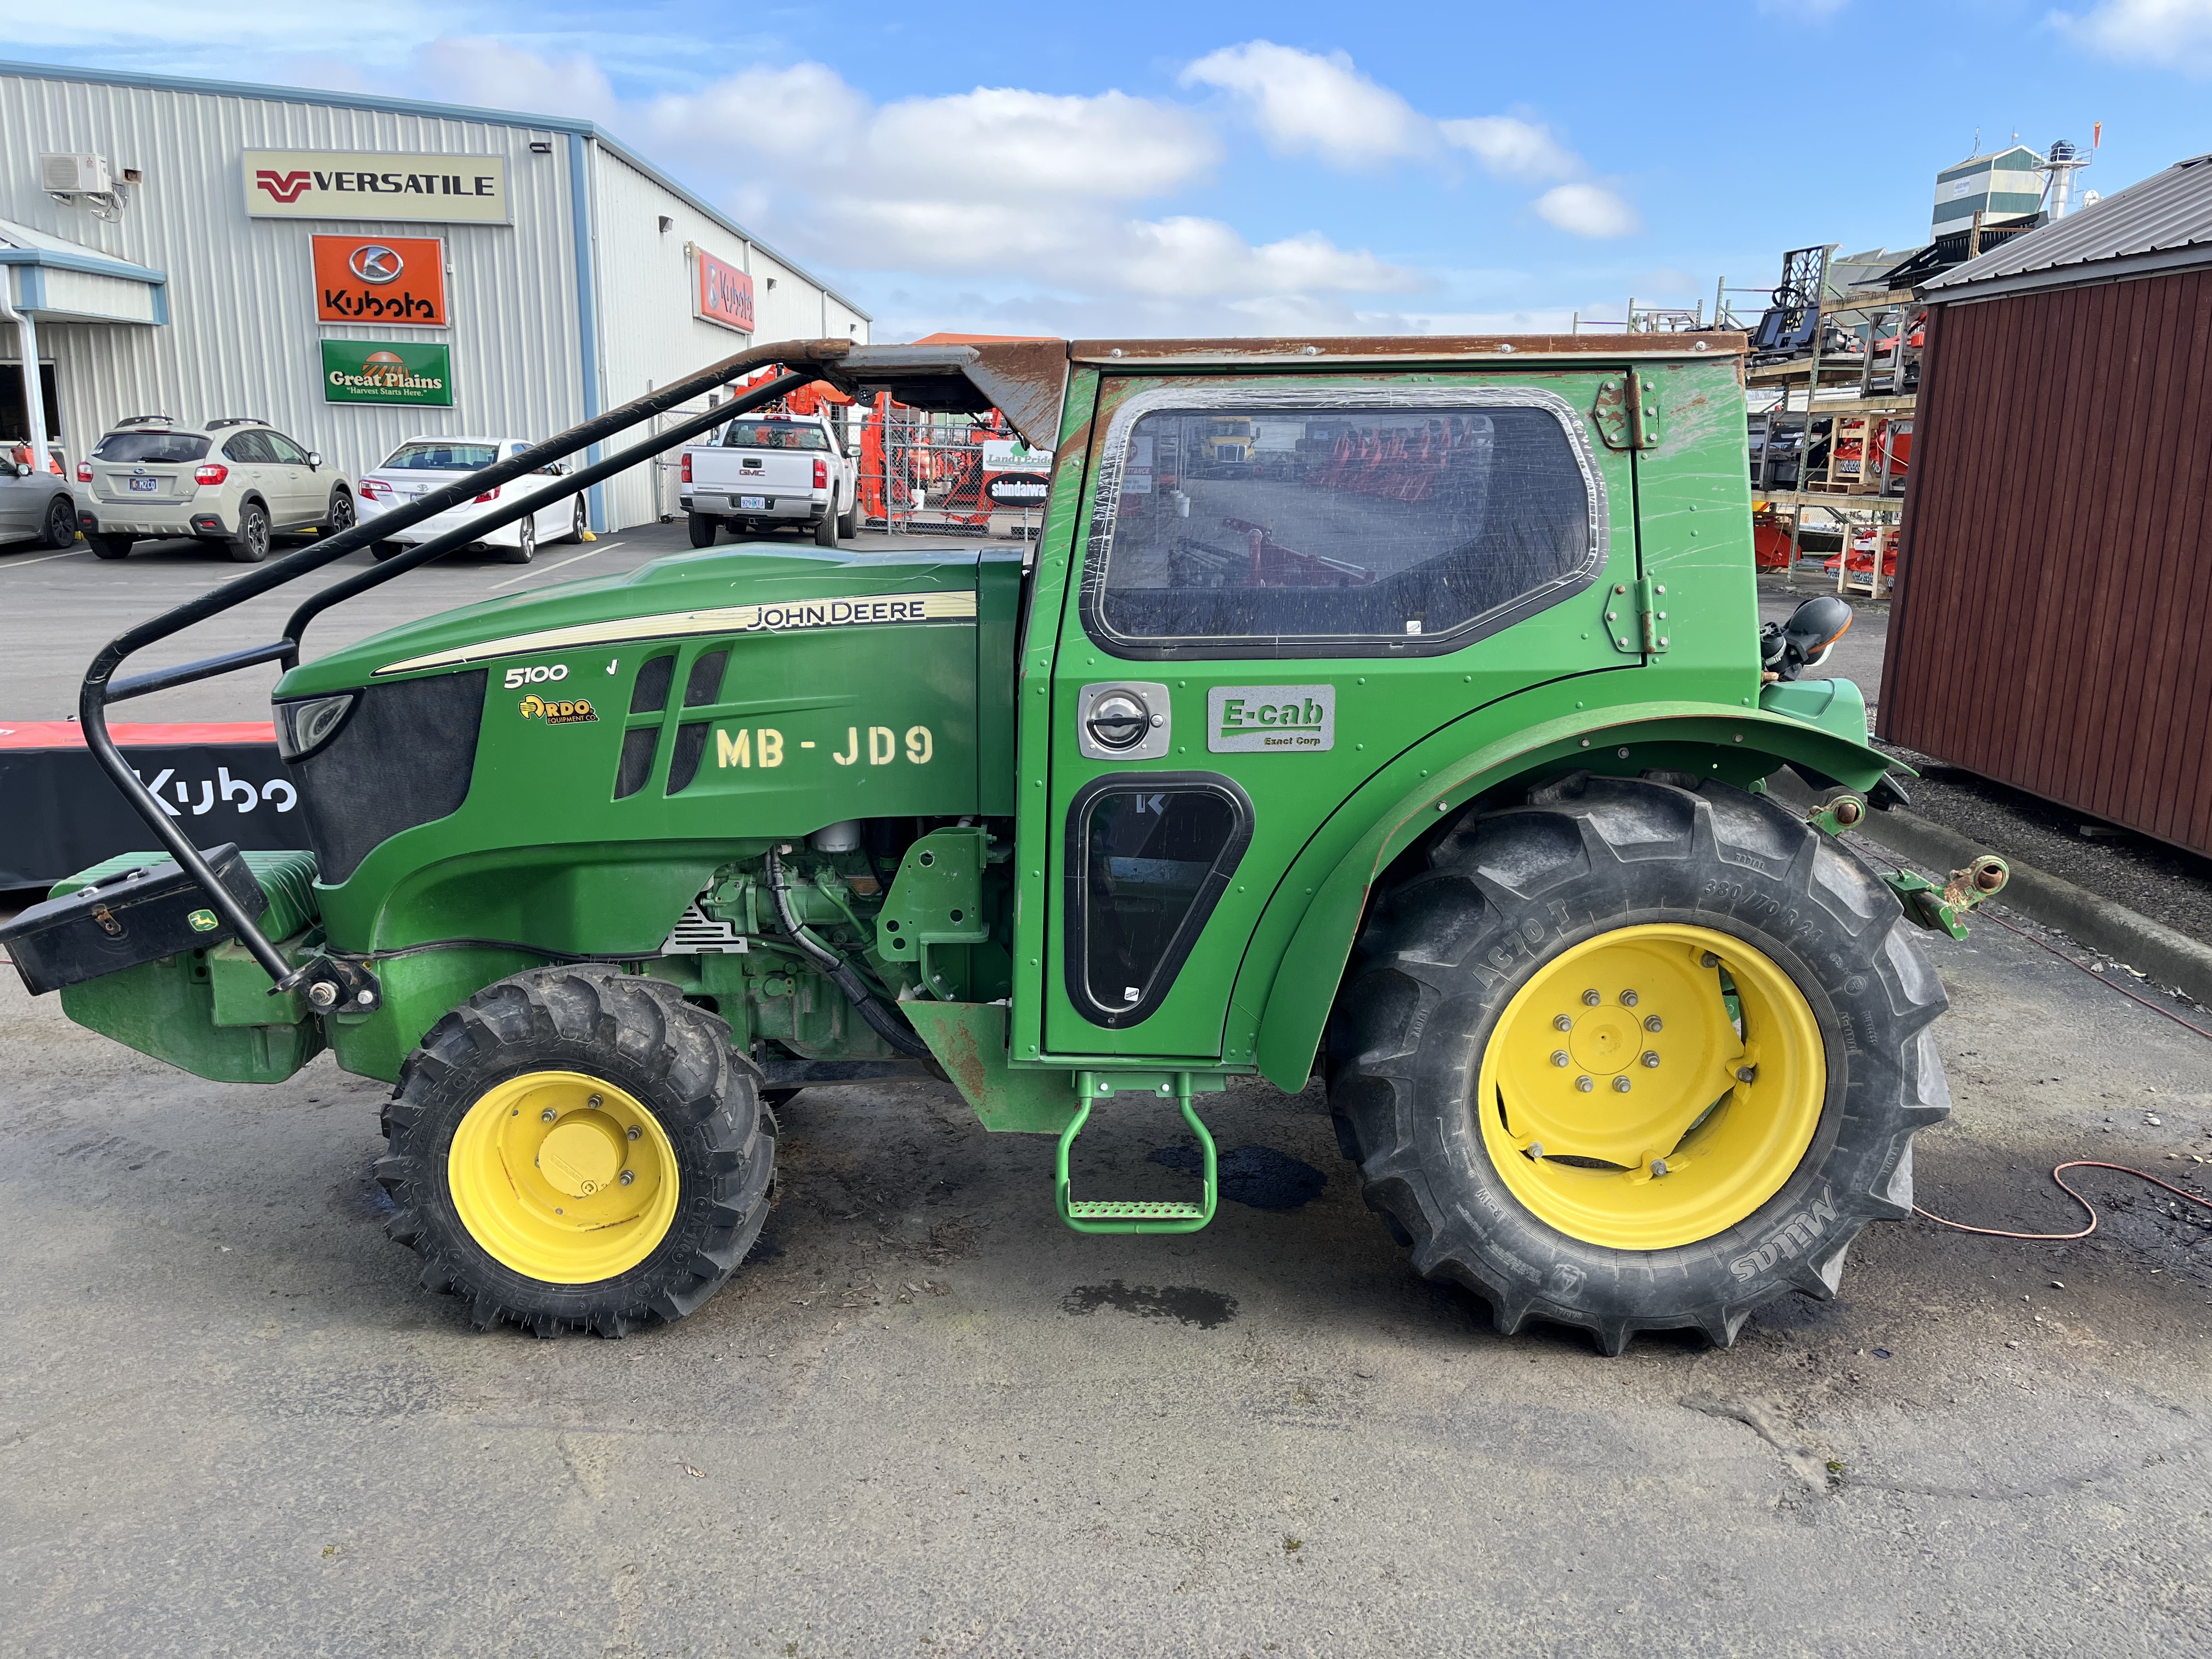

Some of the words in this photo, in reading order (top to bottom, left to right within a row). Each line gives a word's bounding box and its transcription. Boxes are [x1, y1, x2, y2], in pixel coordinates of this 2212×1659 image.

[313, 171, 495, 196] VERSATILE
[325, 289, 435, 318] Kubota
[720, 270, 753, 323] Kubota
[329, 370, 383, 387] Great
[385, 372, 442, 389] Plains
[380, 387, 402, 396] Starts
[989, 454, 1015, 463] Land
[1024, 455, 1053, 464] Pride
[739, 469, 765, 477] GMC
[991, 481, 1047, 496] shindaiwa
[747, 605, 825, 628] JOHN
[831, 601, 926, 622] DEERE
[504, 664, 569, 690] 5100
[548, 714, 584, 724] EQUIPMENT
[1221, 698, 1323, 725] E-cab
[716, 728, 784, 768] MB
[833, 725, 933, 766] JD9
[1264, 737, 1294, 746] Exact
[1296, 736, 1321, 746] Corp
[1735, 853, 1765, 870] RADIAL
[1546, 898, 1570, 925] T
[1704, 878, 1780, 916] 380/70
[1782, 908, 1798, 927] R
[1797, 920, 1823, 943] 24
[1410, 1009, 1428, 1038] RADIAL
[1839, 1012, 1858, 1051] AS-RADIAL
[1862, 1010, 1878, 1045] TUBELESS
[1475, 1188, 1503, 1219] R-1W
[1729, 1184, 1838, 1284] Mitas
